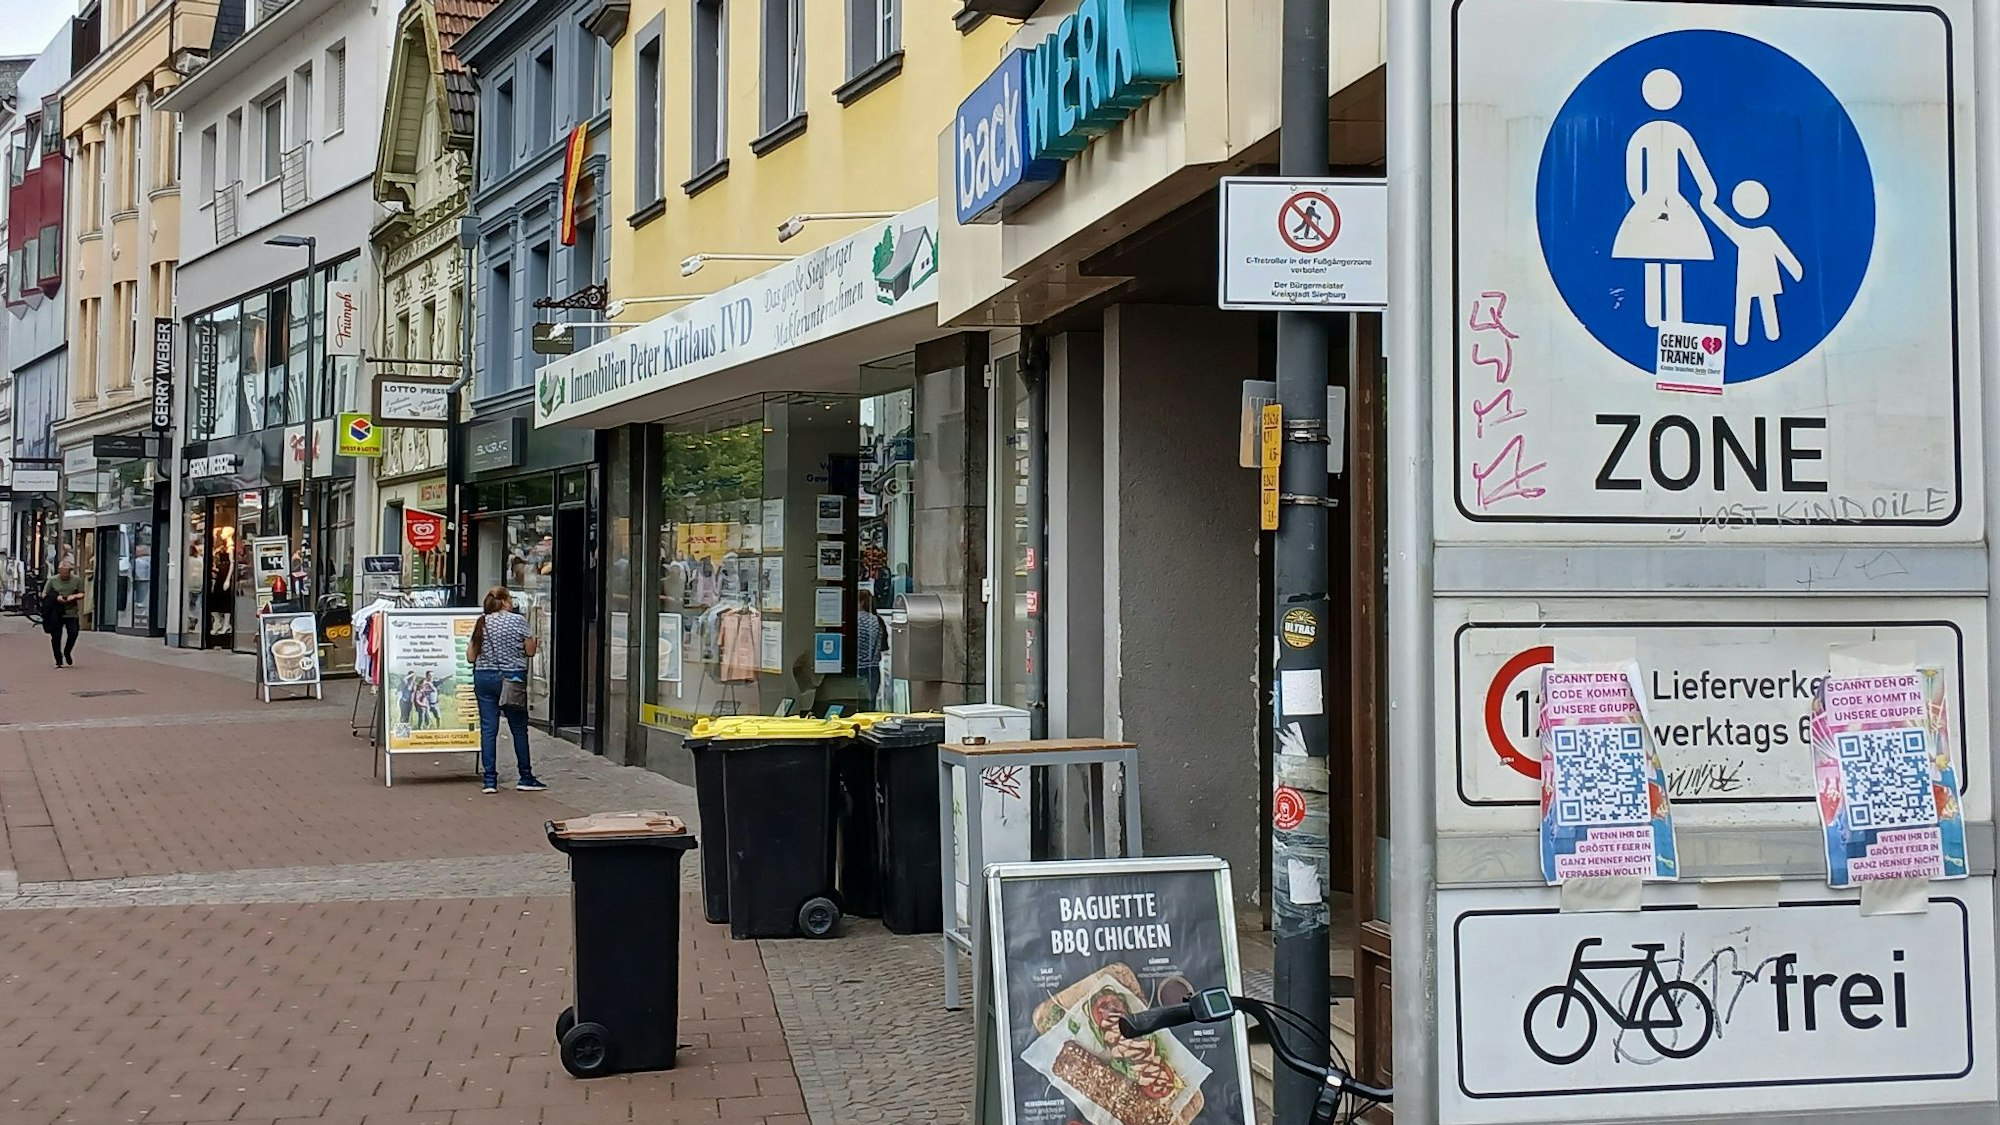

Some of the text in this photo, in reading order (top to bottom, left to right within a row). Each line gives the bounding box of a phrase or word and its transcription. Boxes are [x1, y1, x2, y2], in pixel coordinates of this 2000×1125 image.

[960, 71, 1019, 211] back
[765, 240, 854, 312] Das große Siegburger
[1290, 281, 1344, 291] Bürgermeister
[1312, 291, 1346, 299] Siegburg
[335, 291, 358, 348] Triumph
[774, 281, 863, 350] Maklerunternehmen
[1661, 333, 1698, 349] GENUG
[571, 297, 753, 404] Immobilien Peter Kittlaus IVD
[155, 323, 172, 427] GERRY WEBER
[384, 386, 416, 394] LOTTO
[1595, 414, 1827, 492] ZONE
[1285, 622, 1316, 636] ULTRAS
[1549, 674, 1594, 684] SCANNT
[1596, 673, 1617, 682] DEN
[1653, 669, 1822, 700] Lieferverke
[1828, 677, 1919, 692] SCANNT DEN QR-
[1552, 690, 1582, 699] CODE
[1587, 688, 1628, 698] KOMMT
[1832, 692, 1921, 706] CODE KOMMT IN
[1554, 704, 1596, 714] UNSERE
[1834, 706, 1924, 721] UNSERE GRUPPE
[1515, 690, 1541, 738] 1
[1654, 717, 1788, 752] werktags
[1590, 830, 1650, 840] WENN IHR DIE
[1880, 831, 1938, 842] WENN IHR DIE
[1616, 843, 1640, 851] FEIER
[1642, 842, 1651, 850] IN
[1906, 844, 1929, 852] FEIER
[1560, 855, 1652, 866] GANZ HENNEF NICHT
[1853, 855, 1940, 870] GANZ HENNEF NICHT
[1559, 868, 1613, 878] VERPASSEN
[1852, 870, 1902, 882] VERPASSEN
[1059, 892, 1157, 922] BAGUETTE
[1050, 923, 1172, 957] BBQ CHICKEN
[1771, 950, 1907, 1032] frei
